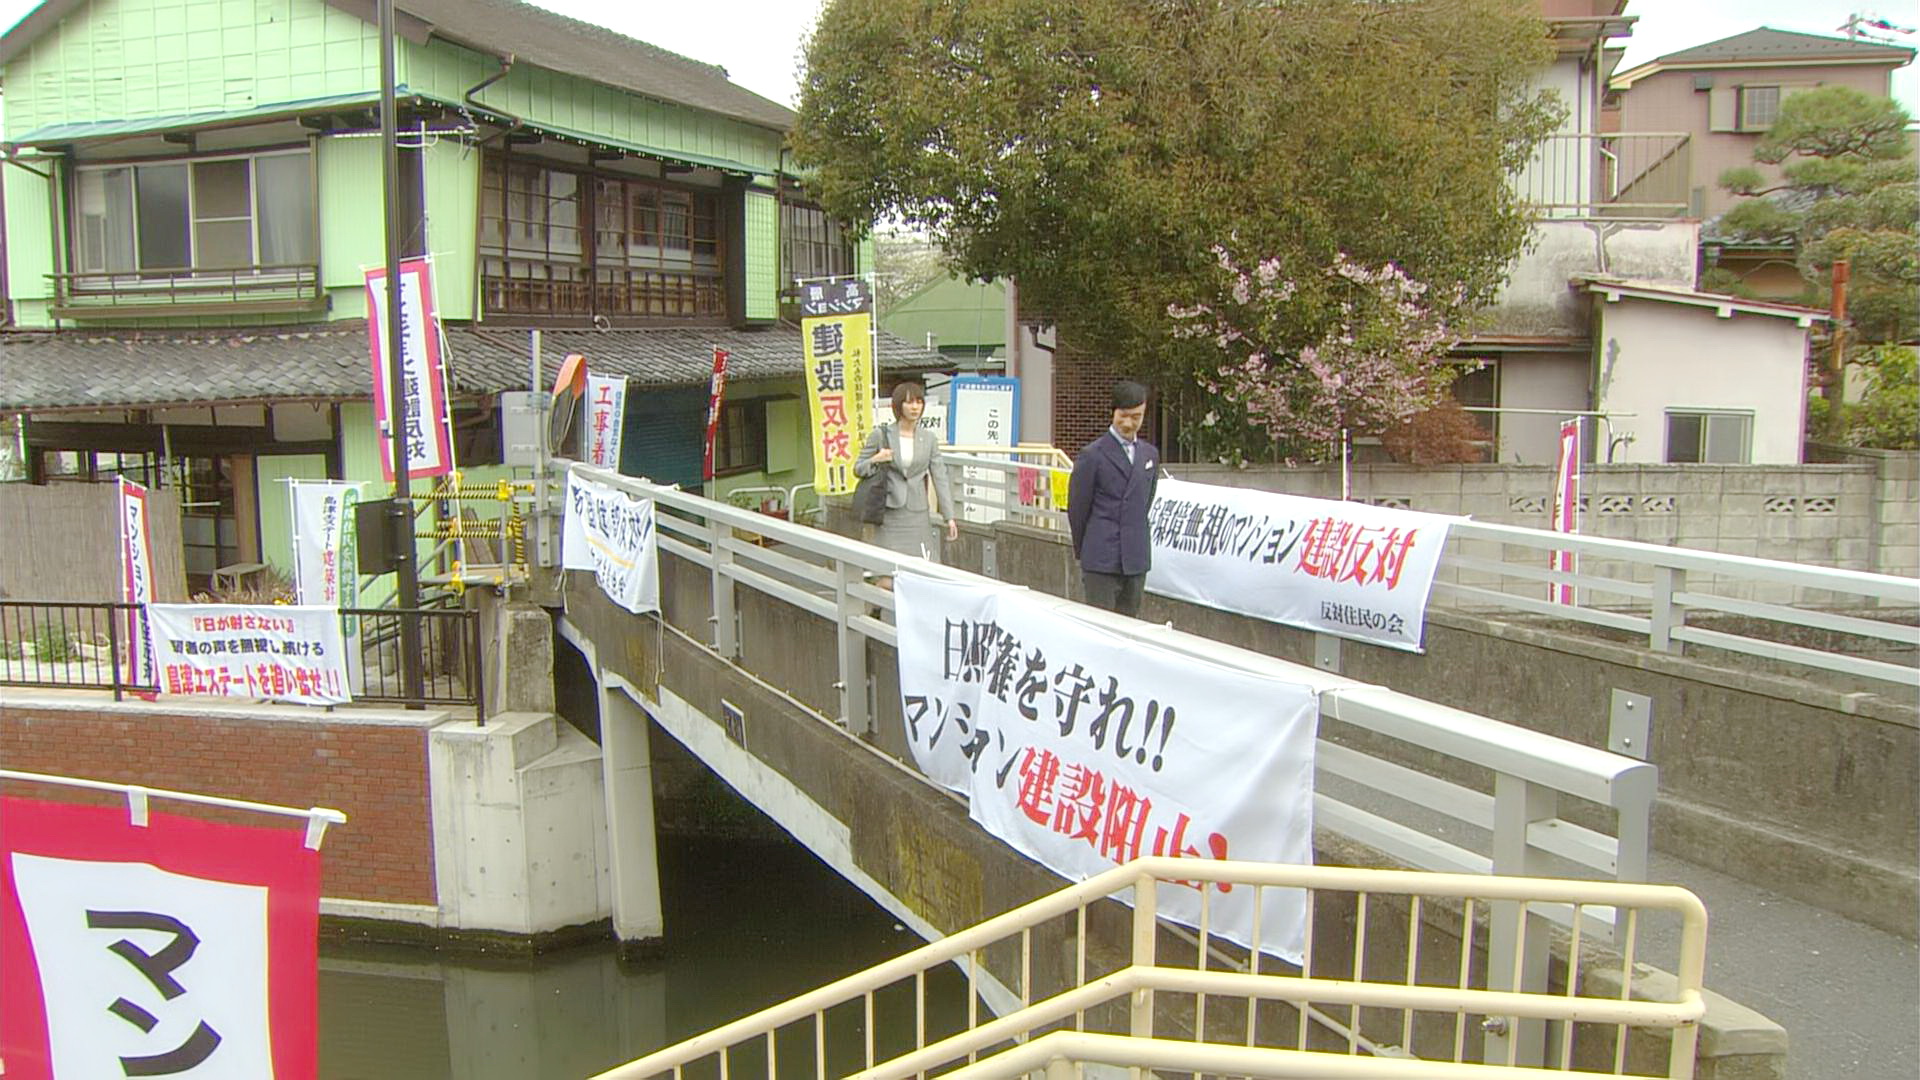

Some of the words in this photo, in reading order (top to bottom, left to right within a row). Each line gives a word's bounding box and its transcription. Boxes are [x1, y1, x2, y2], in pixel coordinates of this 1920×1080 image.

[1321, 600, 1404, 636] 反対住民の会
[84, 909, 223, 1077] マン
